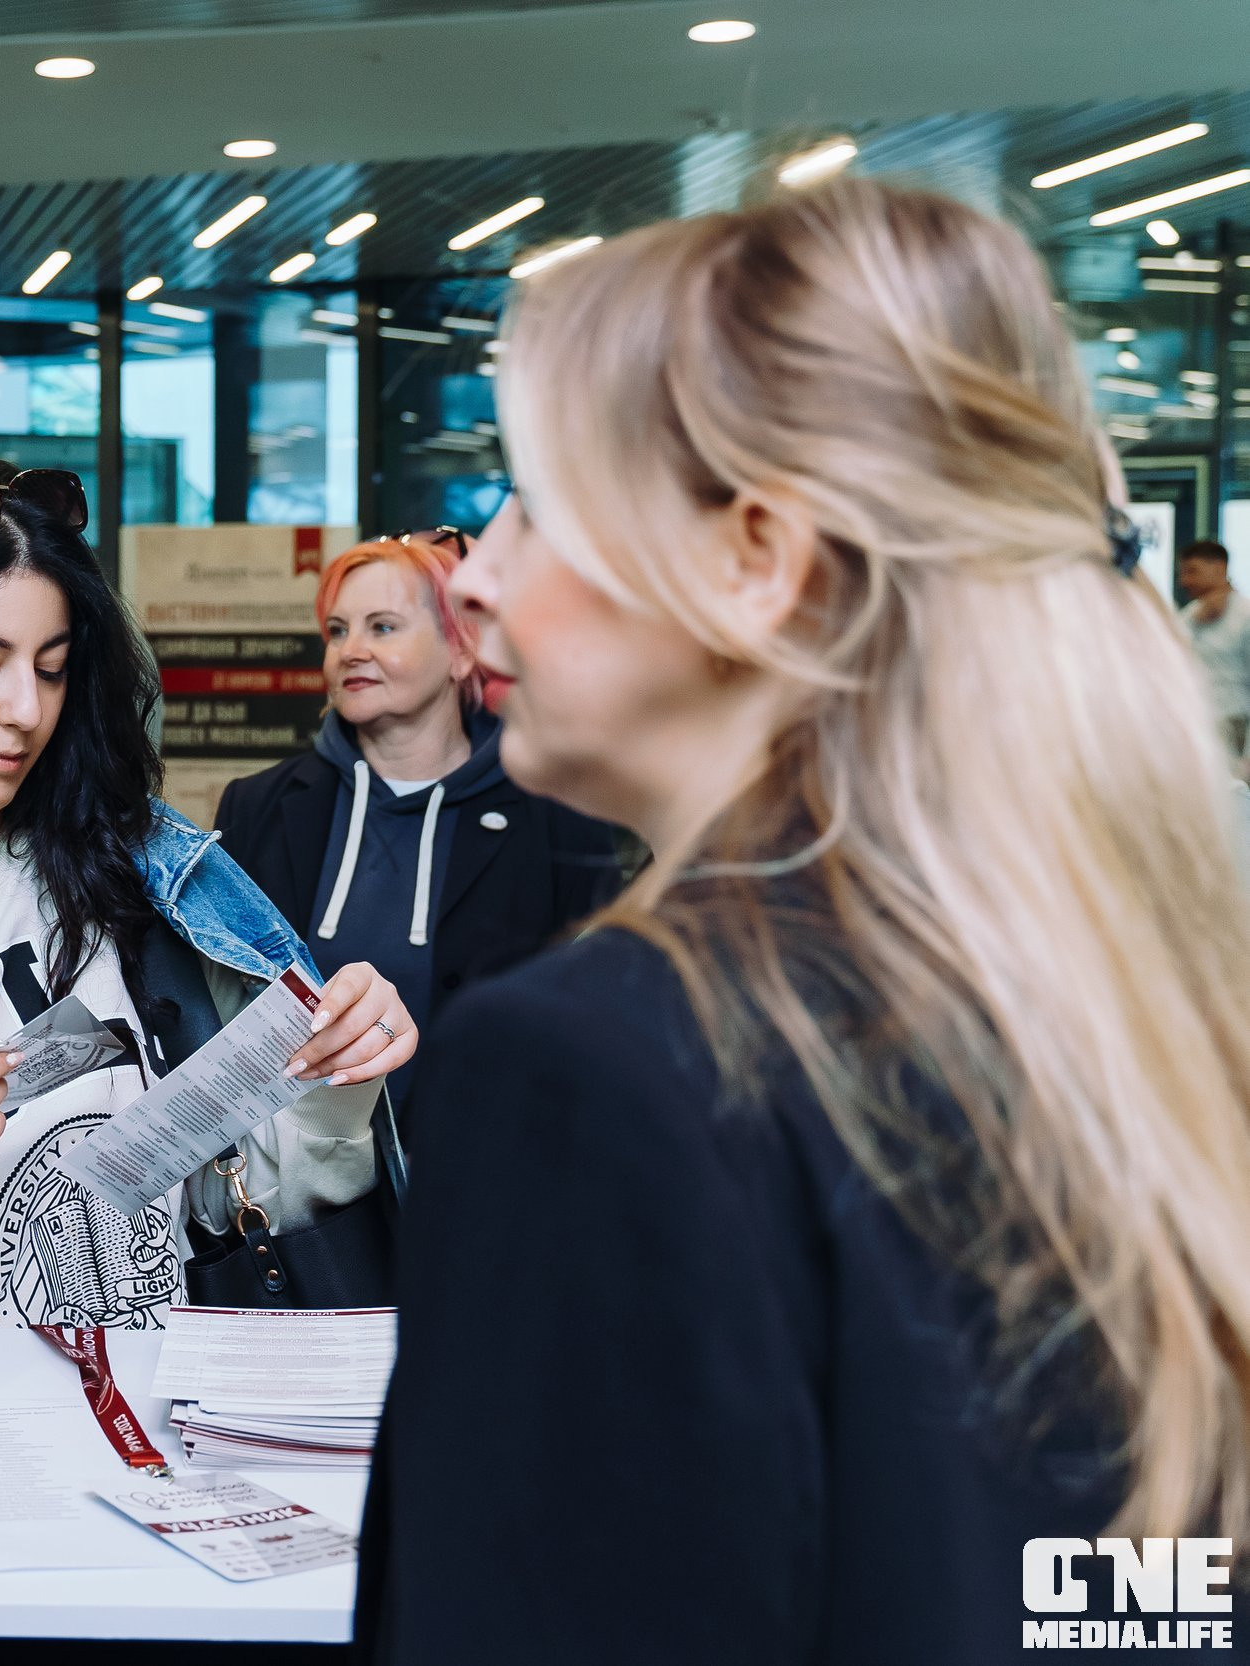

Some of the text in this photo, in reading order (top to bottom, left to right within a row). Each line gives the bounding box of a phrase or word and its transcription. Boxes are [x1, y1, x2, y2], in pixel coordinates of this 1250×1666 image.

[132, 1275, 176, 1295] LIGHT
[63, 1306, 84, 1325] LET
[112, 1413, 145, 1453] РУМ 2023
[163, 1505, 303, 1533] УЧАСТНИК
